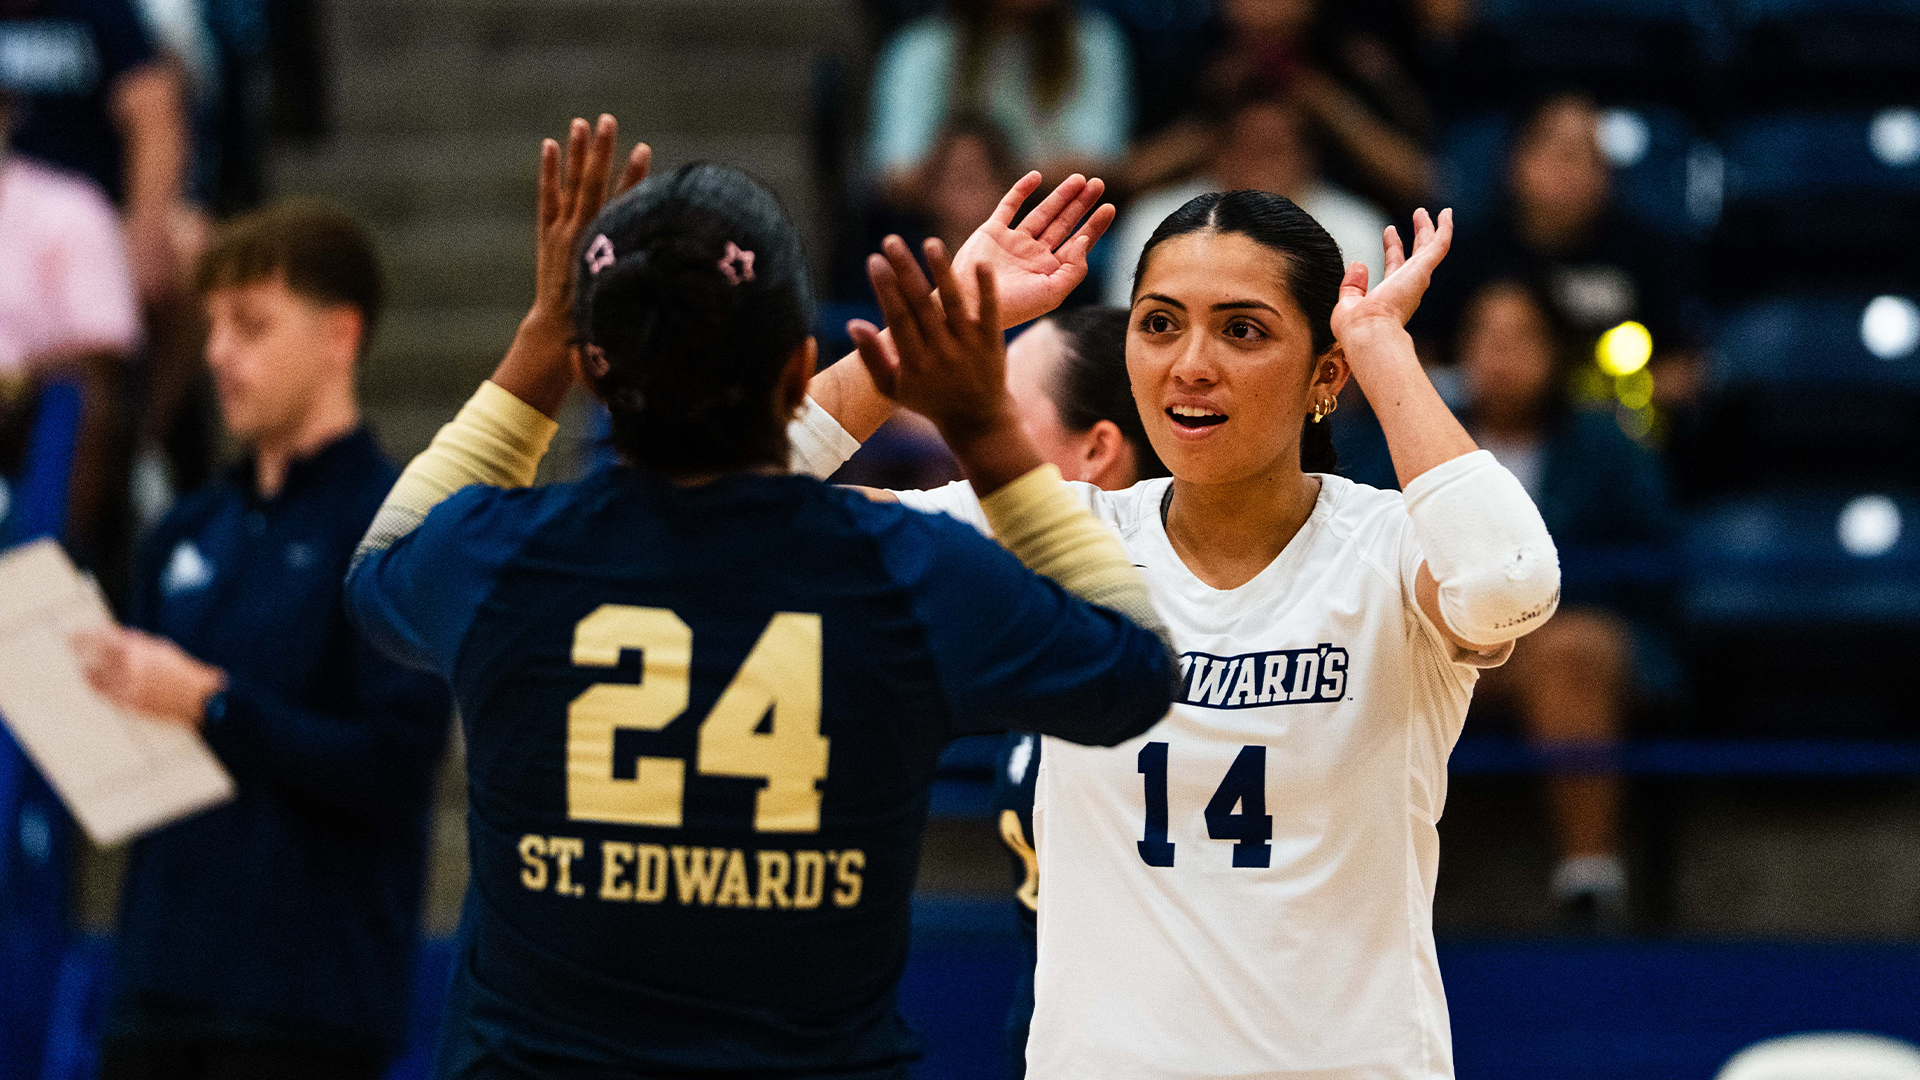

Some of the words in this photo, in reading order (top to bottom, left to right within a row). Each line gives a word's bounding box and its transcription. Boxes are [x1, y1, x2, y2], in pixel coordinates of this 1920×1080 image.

[566, 603, 830, 833] 24
[1179, 647, 1346, 706] WARD'S
[1137, 741, 1273, 868] 14
[518, 834, 585, 898] ST.
[600, 840, 866, 909] EDWARD'S
